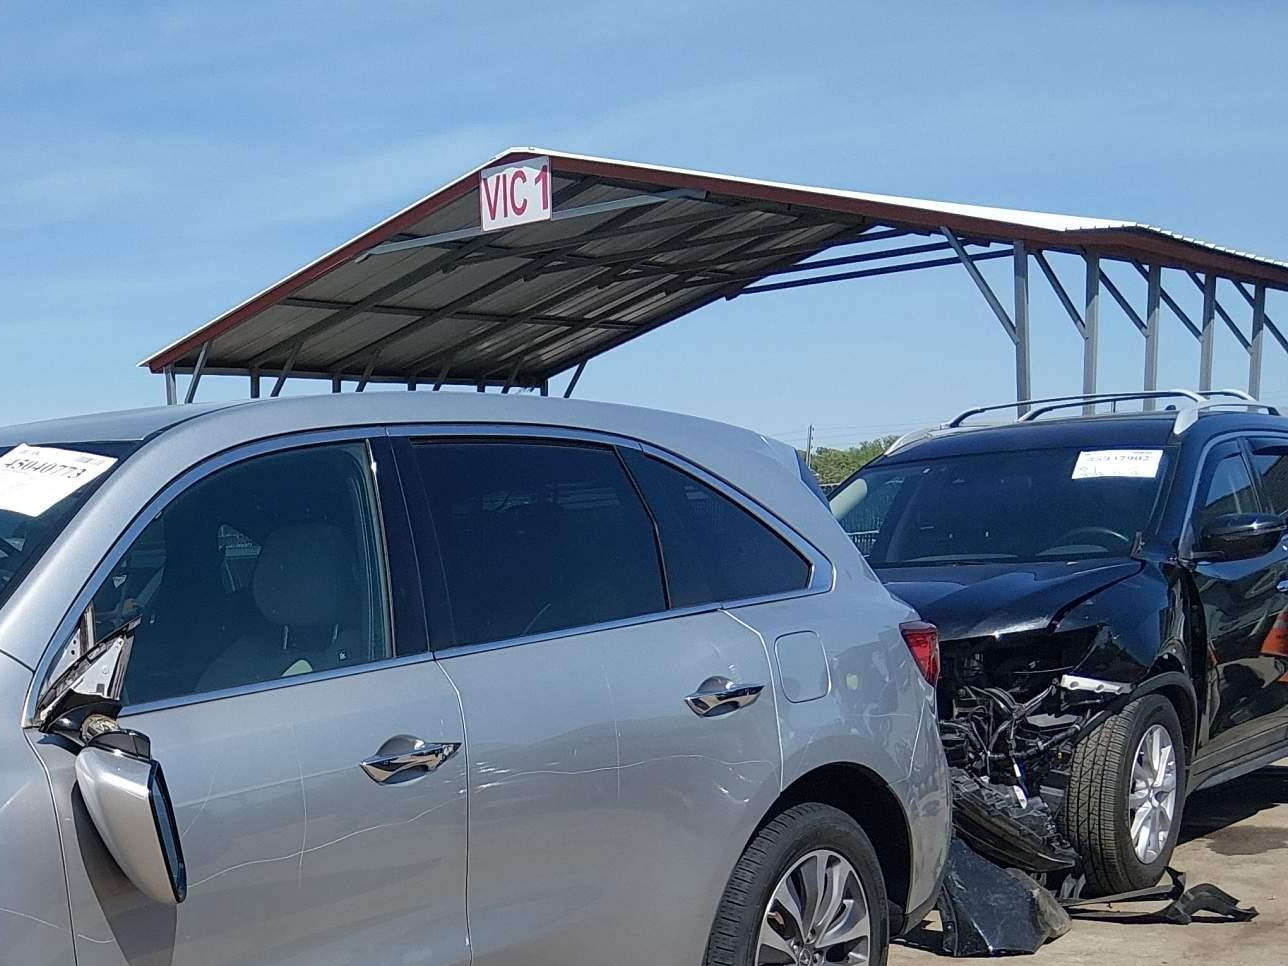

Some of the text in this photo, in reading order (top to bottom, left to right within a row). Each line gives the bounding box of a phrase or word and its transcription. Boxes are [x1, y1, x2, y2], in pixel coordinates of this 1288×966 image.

[482, 164, 549, 220] VIC 1
[4, 458, 87, 478] 45040773
